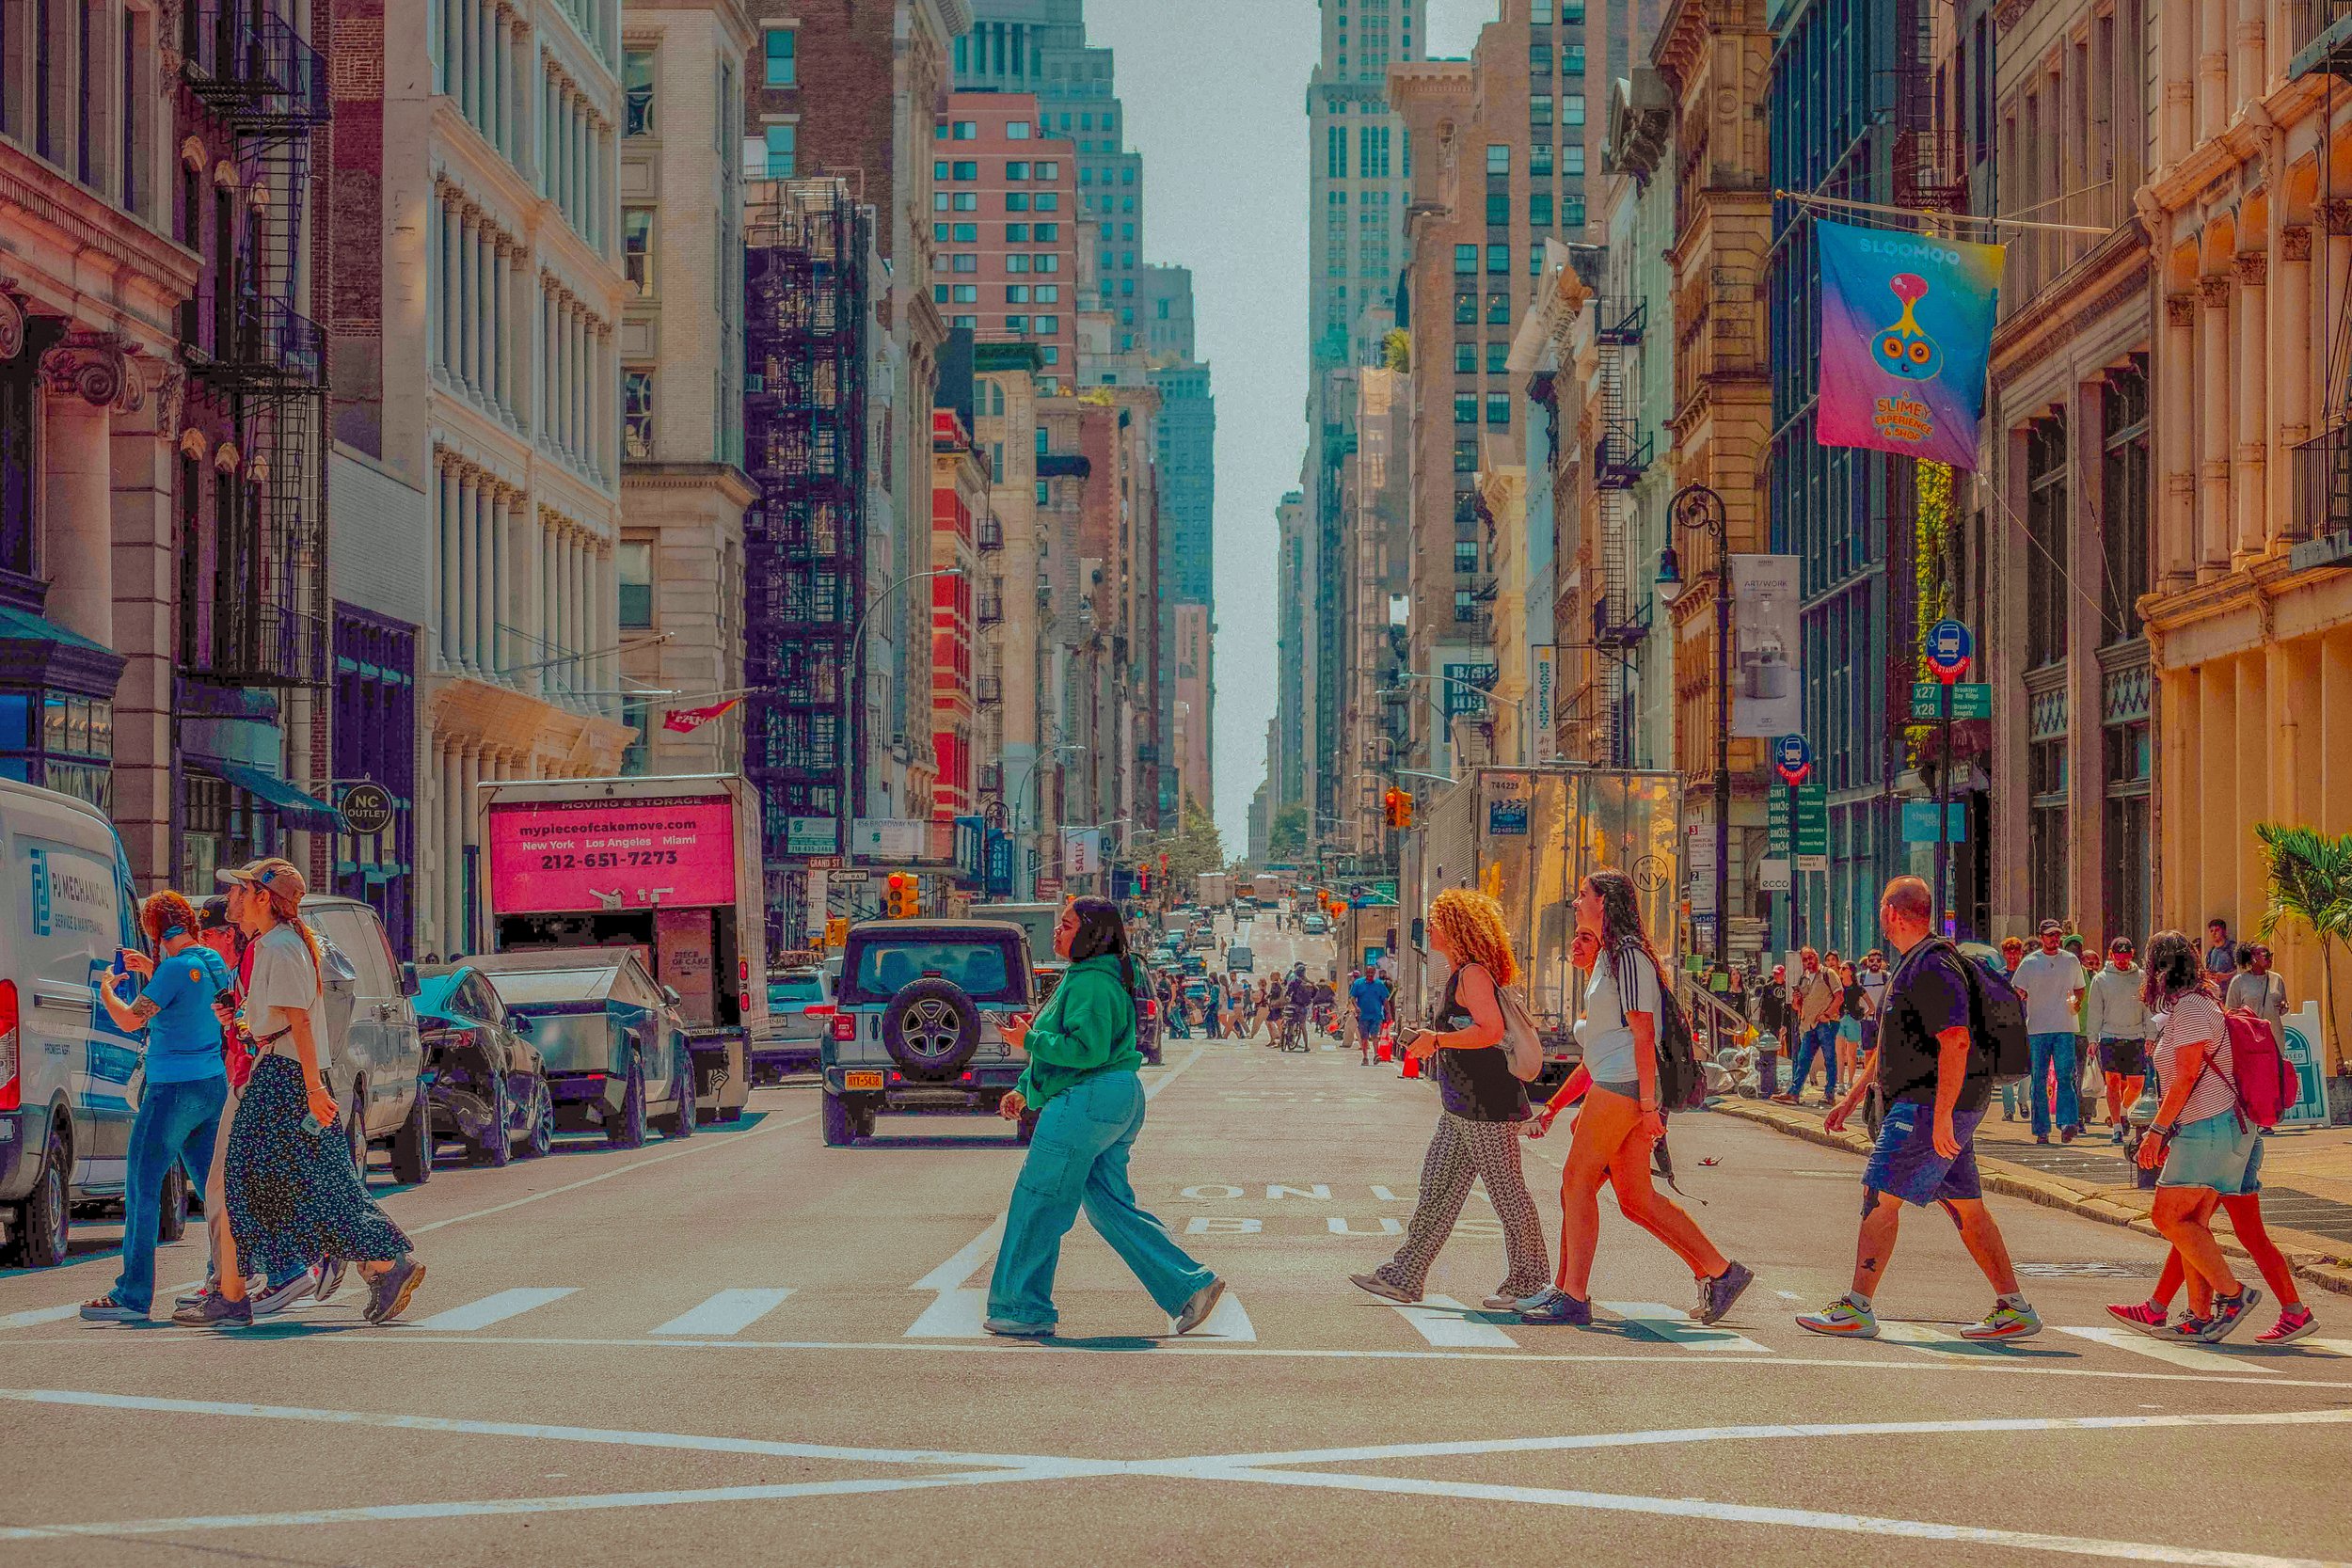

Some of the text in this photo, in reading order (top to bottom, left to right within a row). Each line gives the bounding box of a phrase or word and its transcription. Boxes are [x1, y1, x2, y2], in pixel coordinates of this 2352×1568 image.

[1859, 238, 1961, 266] SLOOMOO
[1902, 390, 1910, 399] A
[1877, 398, 1931, 420] SLIMEY
[1875, 415, 1933, 436] EXPERIENCE
[1894, 427, 1921, 441] SHOP
[1744, 579, 1788, 588] ART/WORK
[1929, 657, 1966, 673] NO STANDING
[1770, 787, 1786, 798] SIM1
[356, 795, 378, 808] NC
[1770, 801, 1789, 811] SIM3c
[348, 809, 386, 818] OUTLET
[1770, 815, 1789, 825] SIM4c
[520, 820, 696, 837] mypieceofcakemove.com
[1770, 828, 1790, 838] SIM33c
[523, 834, 696, 850] New York Los Angeles Miami
[1770, 842, 1789, 851] SIM34
[542, 850, 677, 869] 212-651-7273
[810, 859, 841, 867] GRAND ST
[1075, 842, 1084, 872] SALLY
[1640, 873, 1663, 885] NY
[52, 872, 109, 910] PJ MECHANICAL
